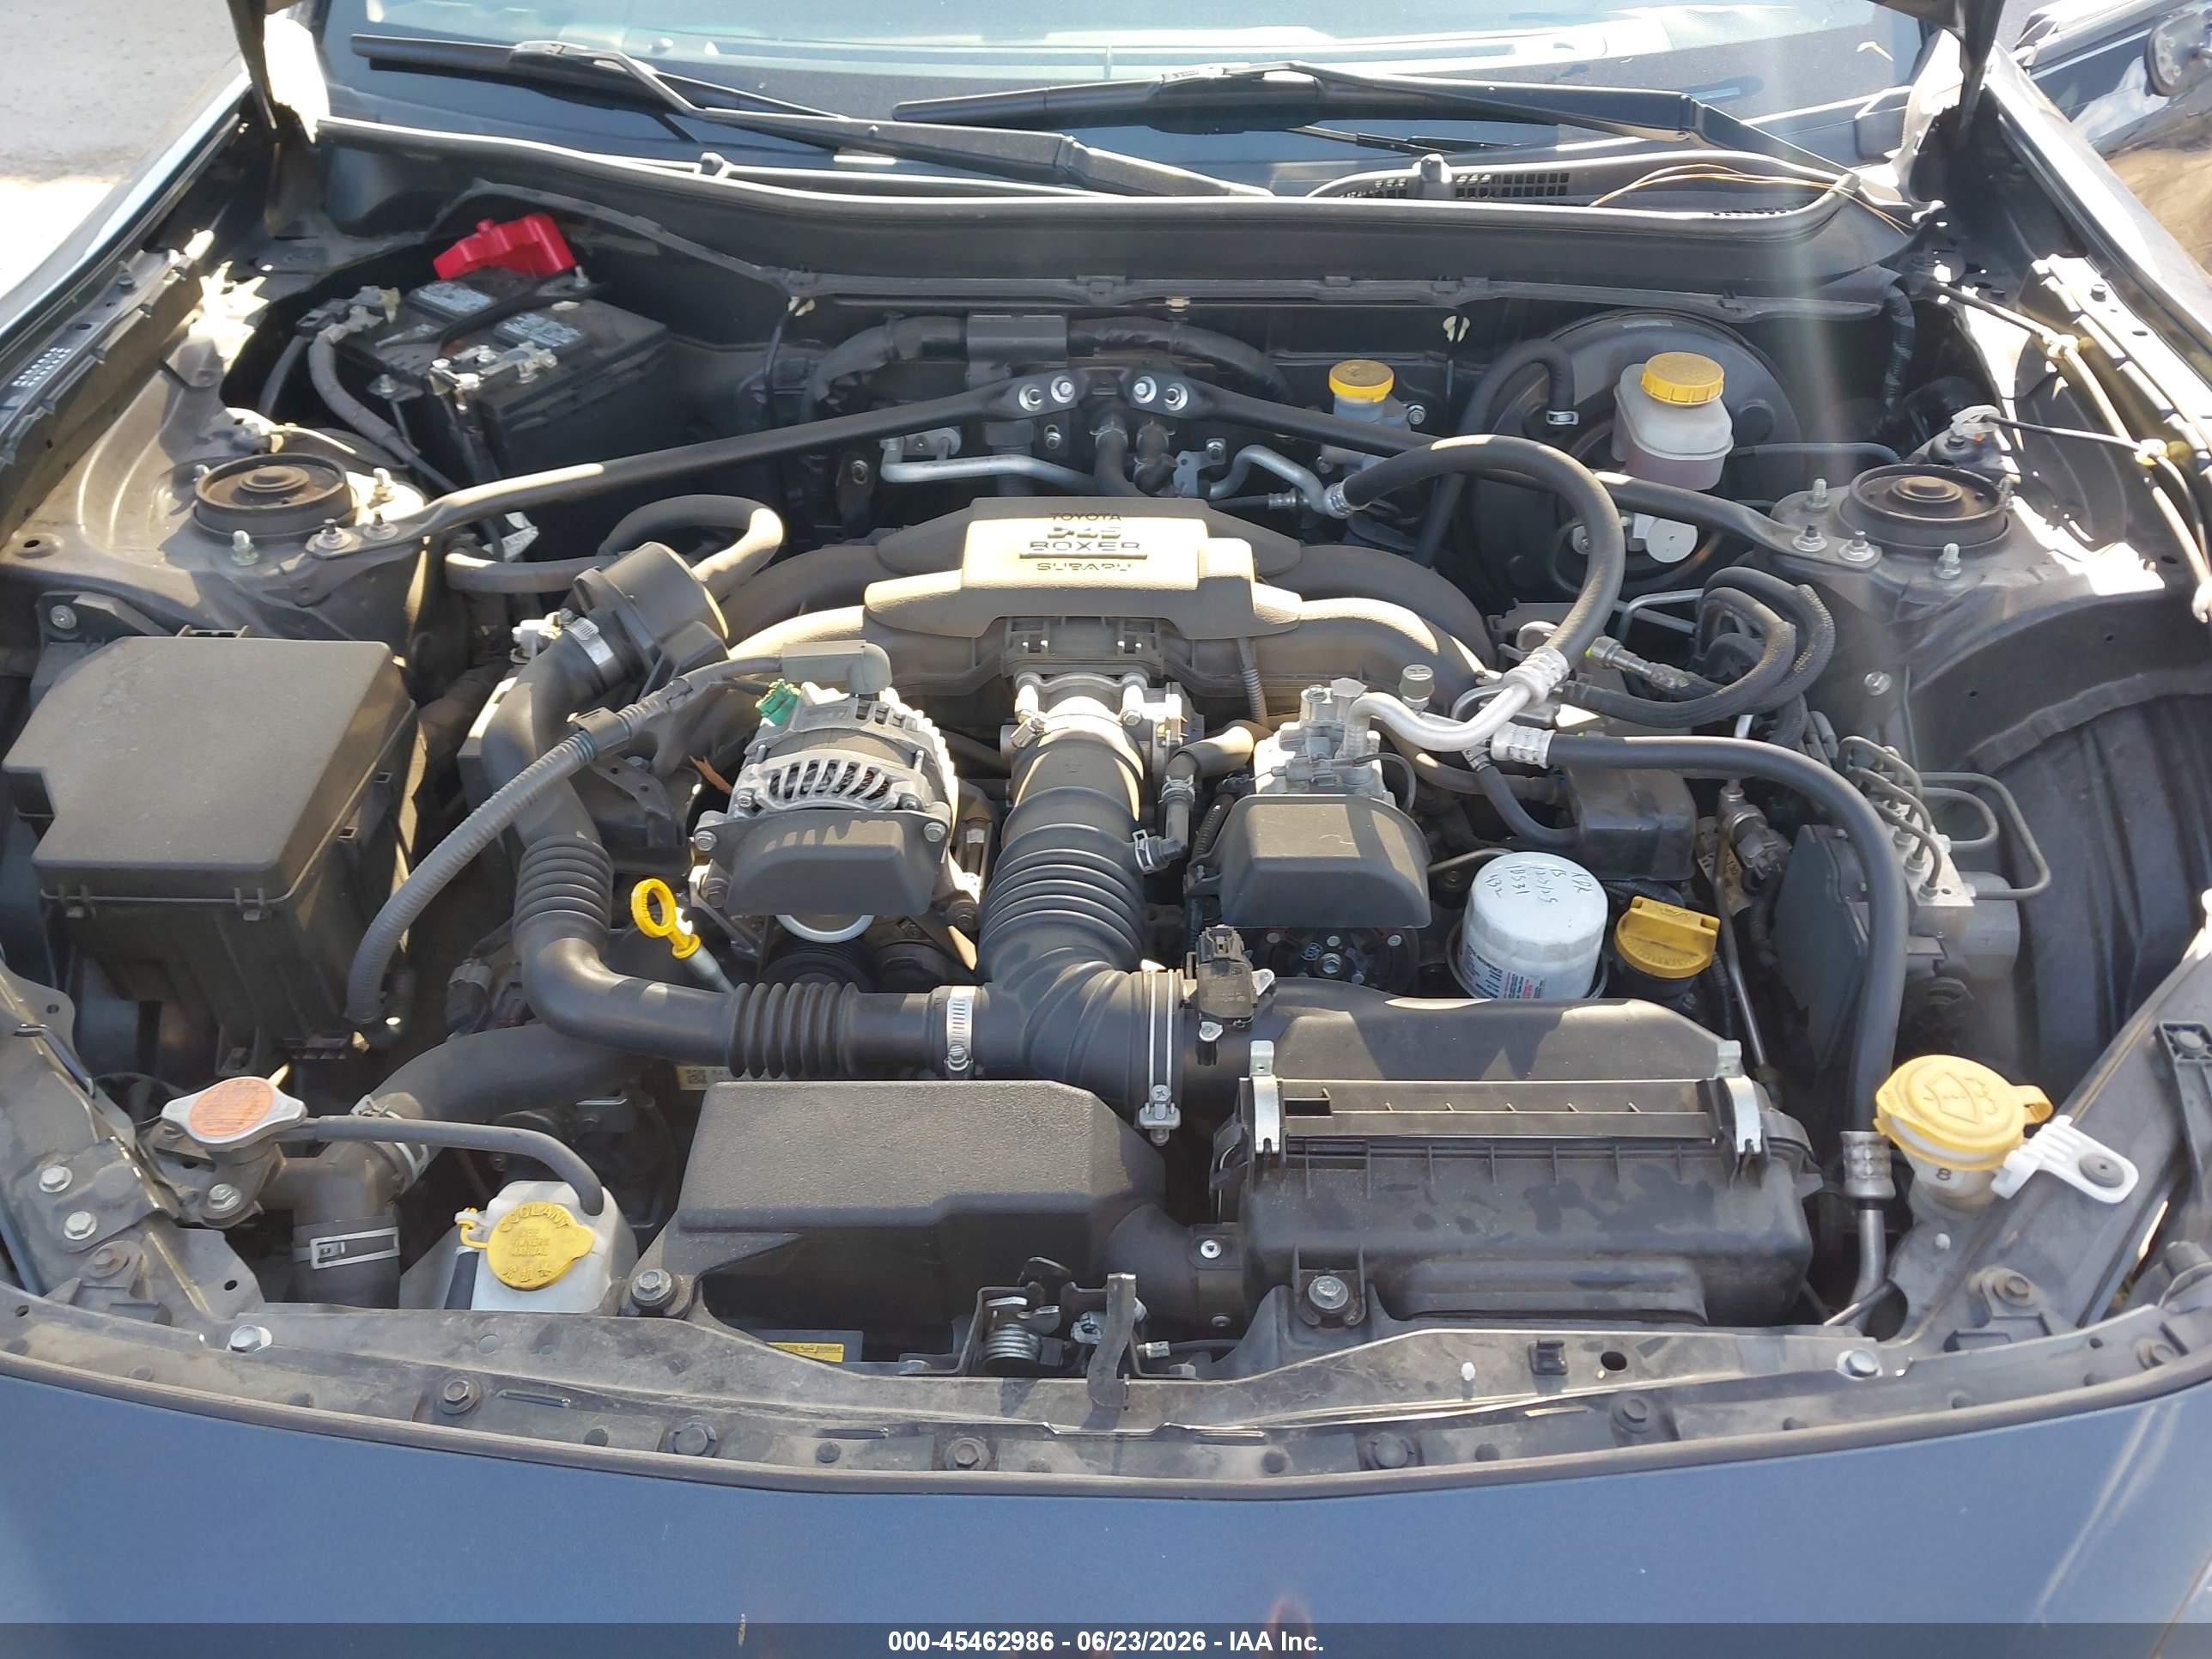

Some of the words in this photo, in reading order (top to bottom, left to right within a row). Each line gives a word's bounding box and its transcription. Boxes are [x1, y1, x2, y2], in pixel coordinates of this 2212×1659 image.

[1048, 512, 1121, 521] TOYOTA
[1030, 541, 1140, 551] BOXER
[1936, 1167, 1952, 1182] 8
[499, 1204, 571, 1232] COOLANT
